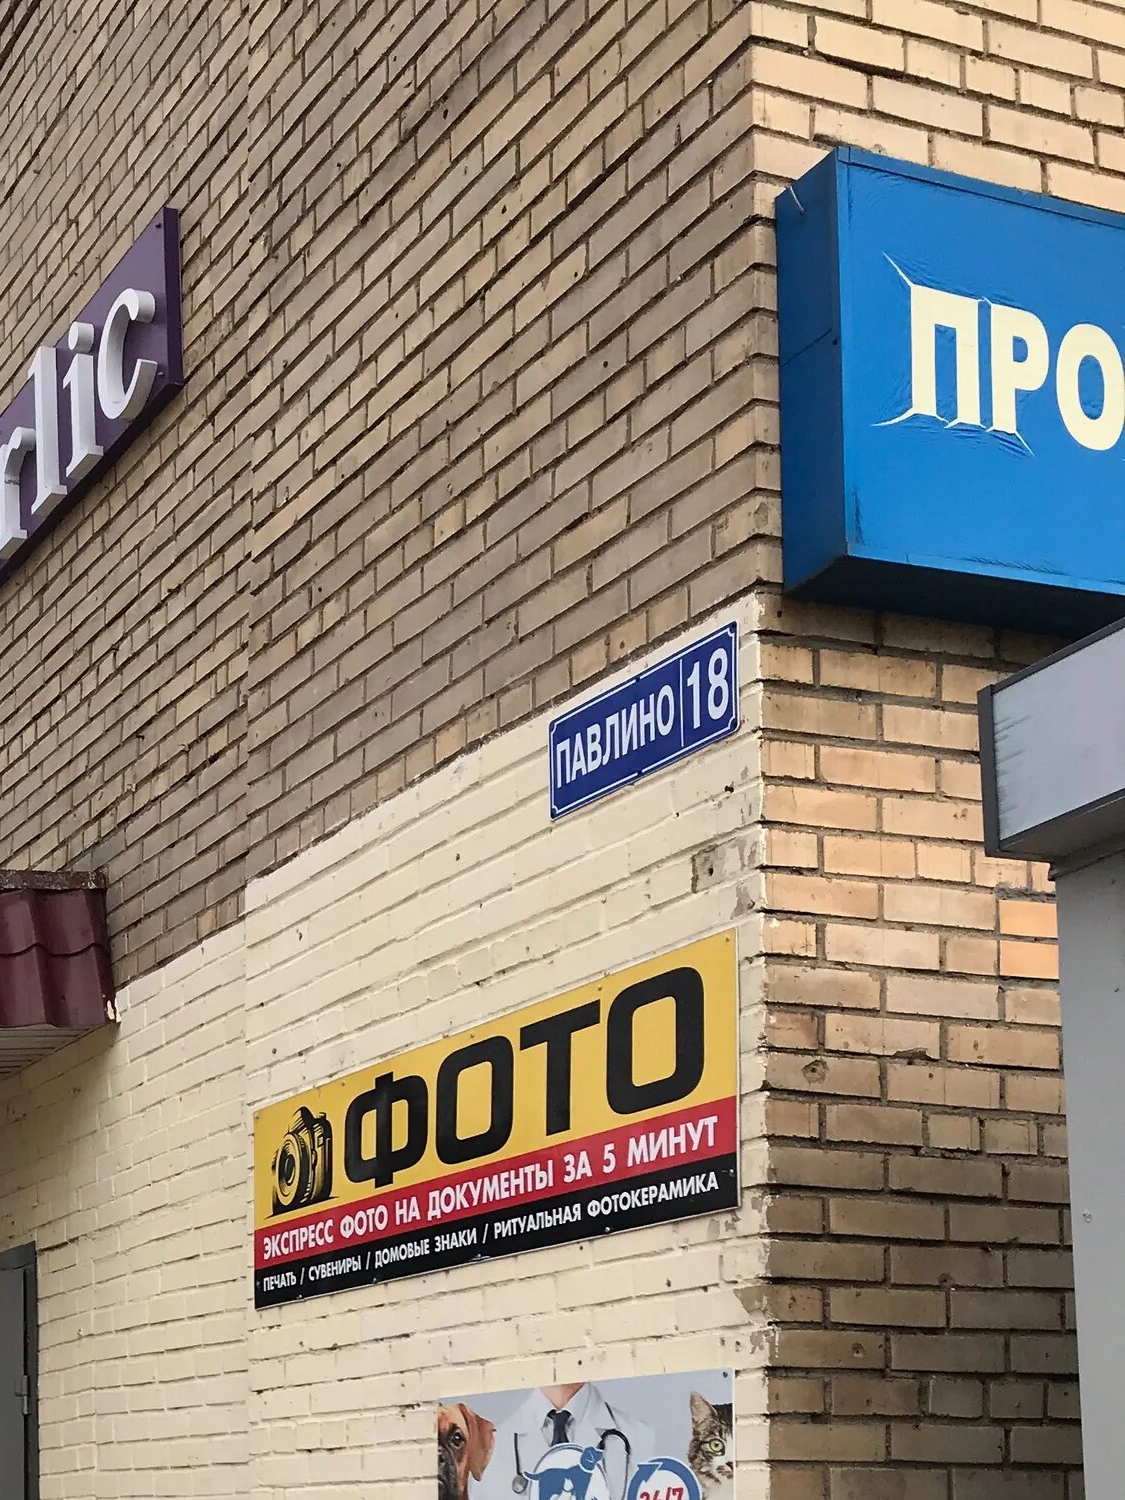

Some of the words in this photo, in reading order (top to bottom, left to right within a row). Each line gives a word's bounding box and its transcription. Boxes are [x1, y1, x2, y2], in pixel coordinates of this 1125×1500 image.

[556, 684, 674, 788] ПАВЛИНО
[687, 648, 729, 729] 18
[344, 967, 705, 1188] ФОТО
[263, 1217, 334, 1260] ЭКСПРЕСС
[339, 1204, 388, 1239] ФОТО
[395, 1197, 421, 1232] НА
[427, 1159, 553, 1224] ДОКУМЕНТЫ
[564, 1154, 592, 1184] ЗА
[603, 1145, 616, 1174] 5
[627, 1116, 717, 1167] МИНУТ
[263, 1270, 296, 1292] ПЕЧАТЬ
[308, 1254, 361, 1282] СУВЕНИРЫ
[375, 1239, 430, 1269] ДОМОВЫЕ
[435, 1228, 477, 1254] ЗНАКИ
[494, 1203, 582, 1239] РИТУАЛЬНАЯ
[587, 1172, 718, 1221] ФОТОКЕРАМИКА
